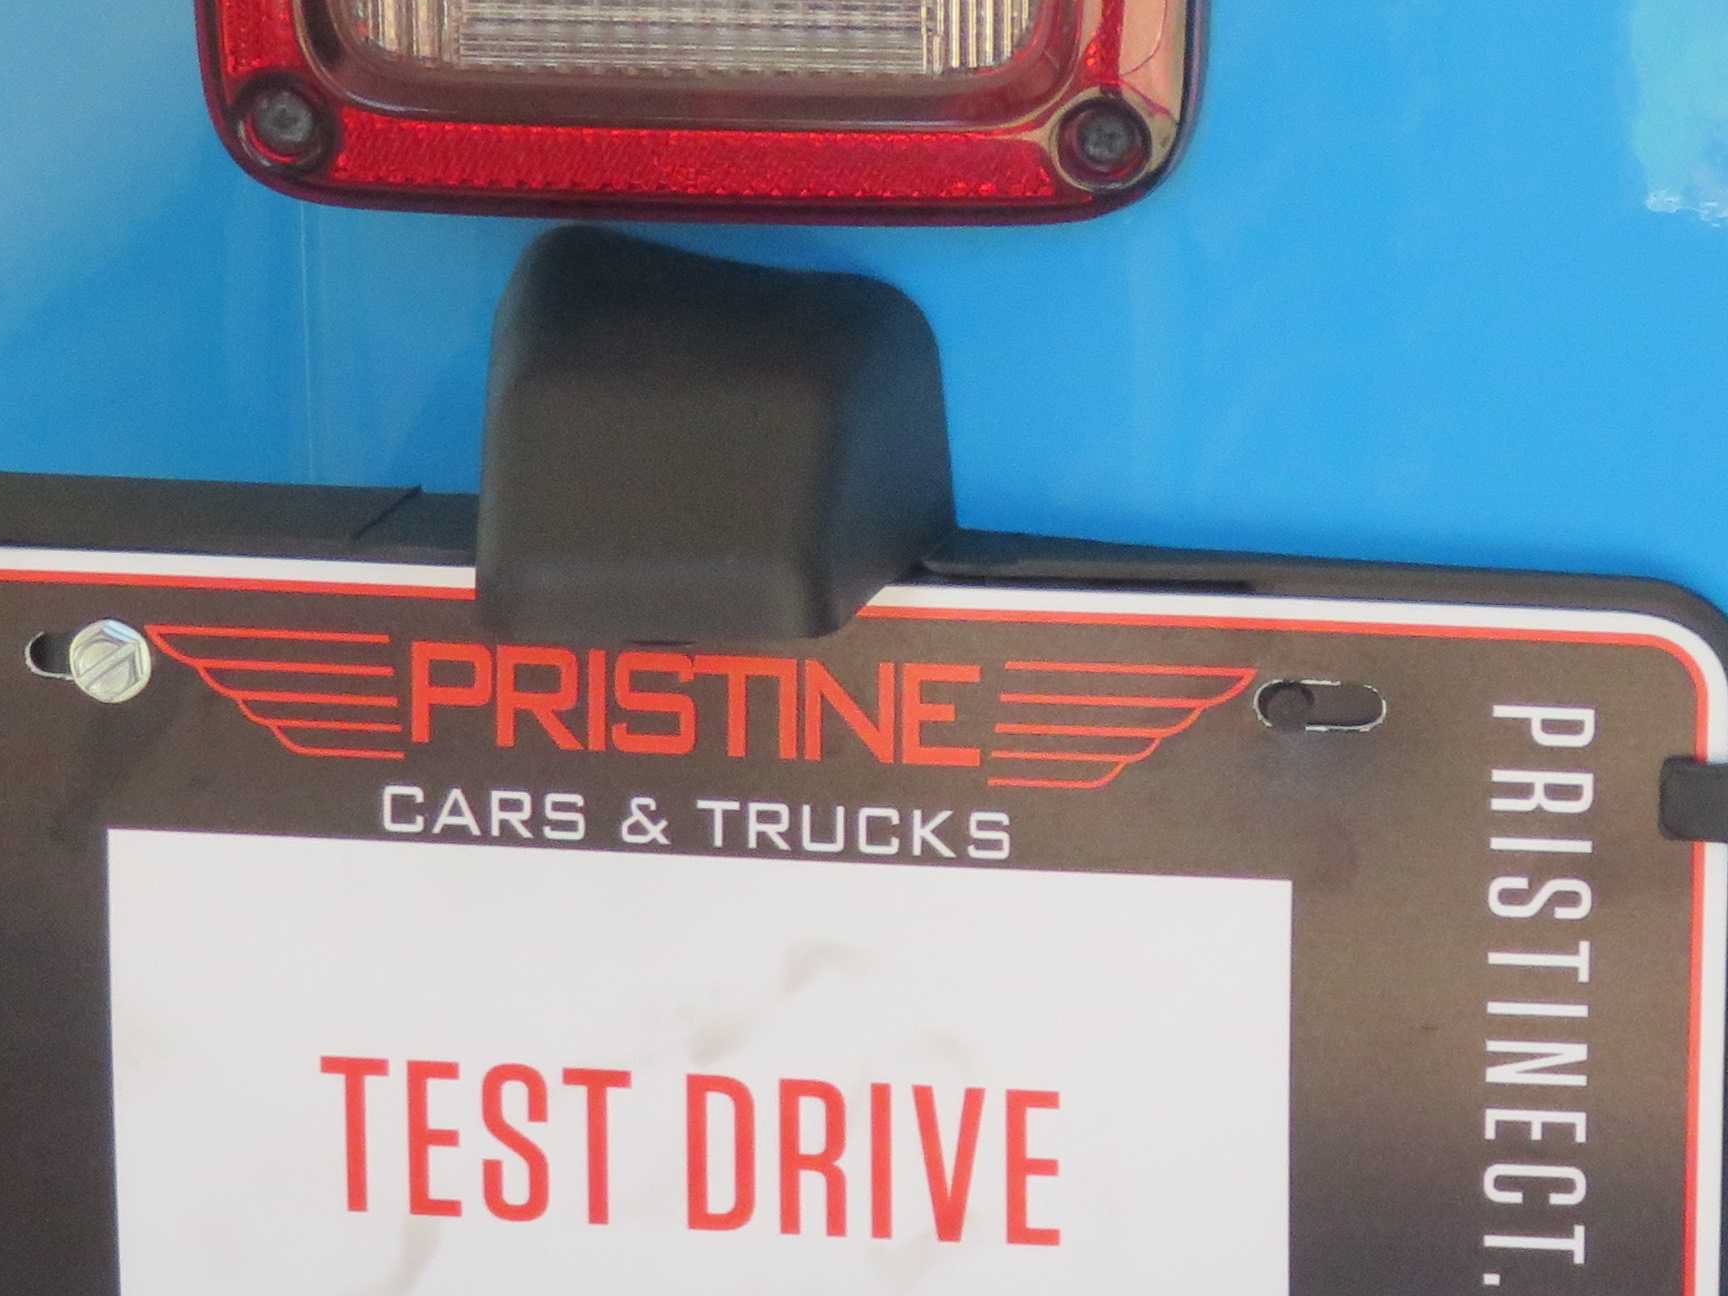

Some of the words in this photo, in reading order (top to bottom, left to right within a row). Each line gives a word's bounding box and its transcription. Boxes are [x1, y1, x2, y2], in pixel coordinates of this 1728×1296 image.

[409, 640, 983, 767] PRISTINE
[381, 785, 588, 840] CARS
[620, 796, 672, 846] &
[696, 799, 1013, 861] TRUCKS
[318, 1054, 632, 1226] TEST
[685, 1072, 1063, 1247] DRIVE
